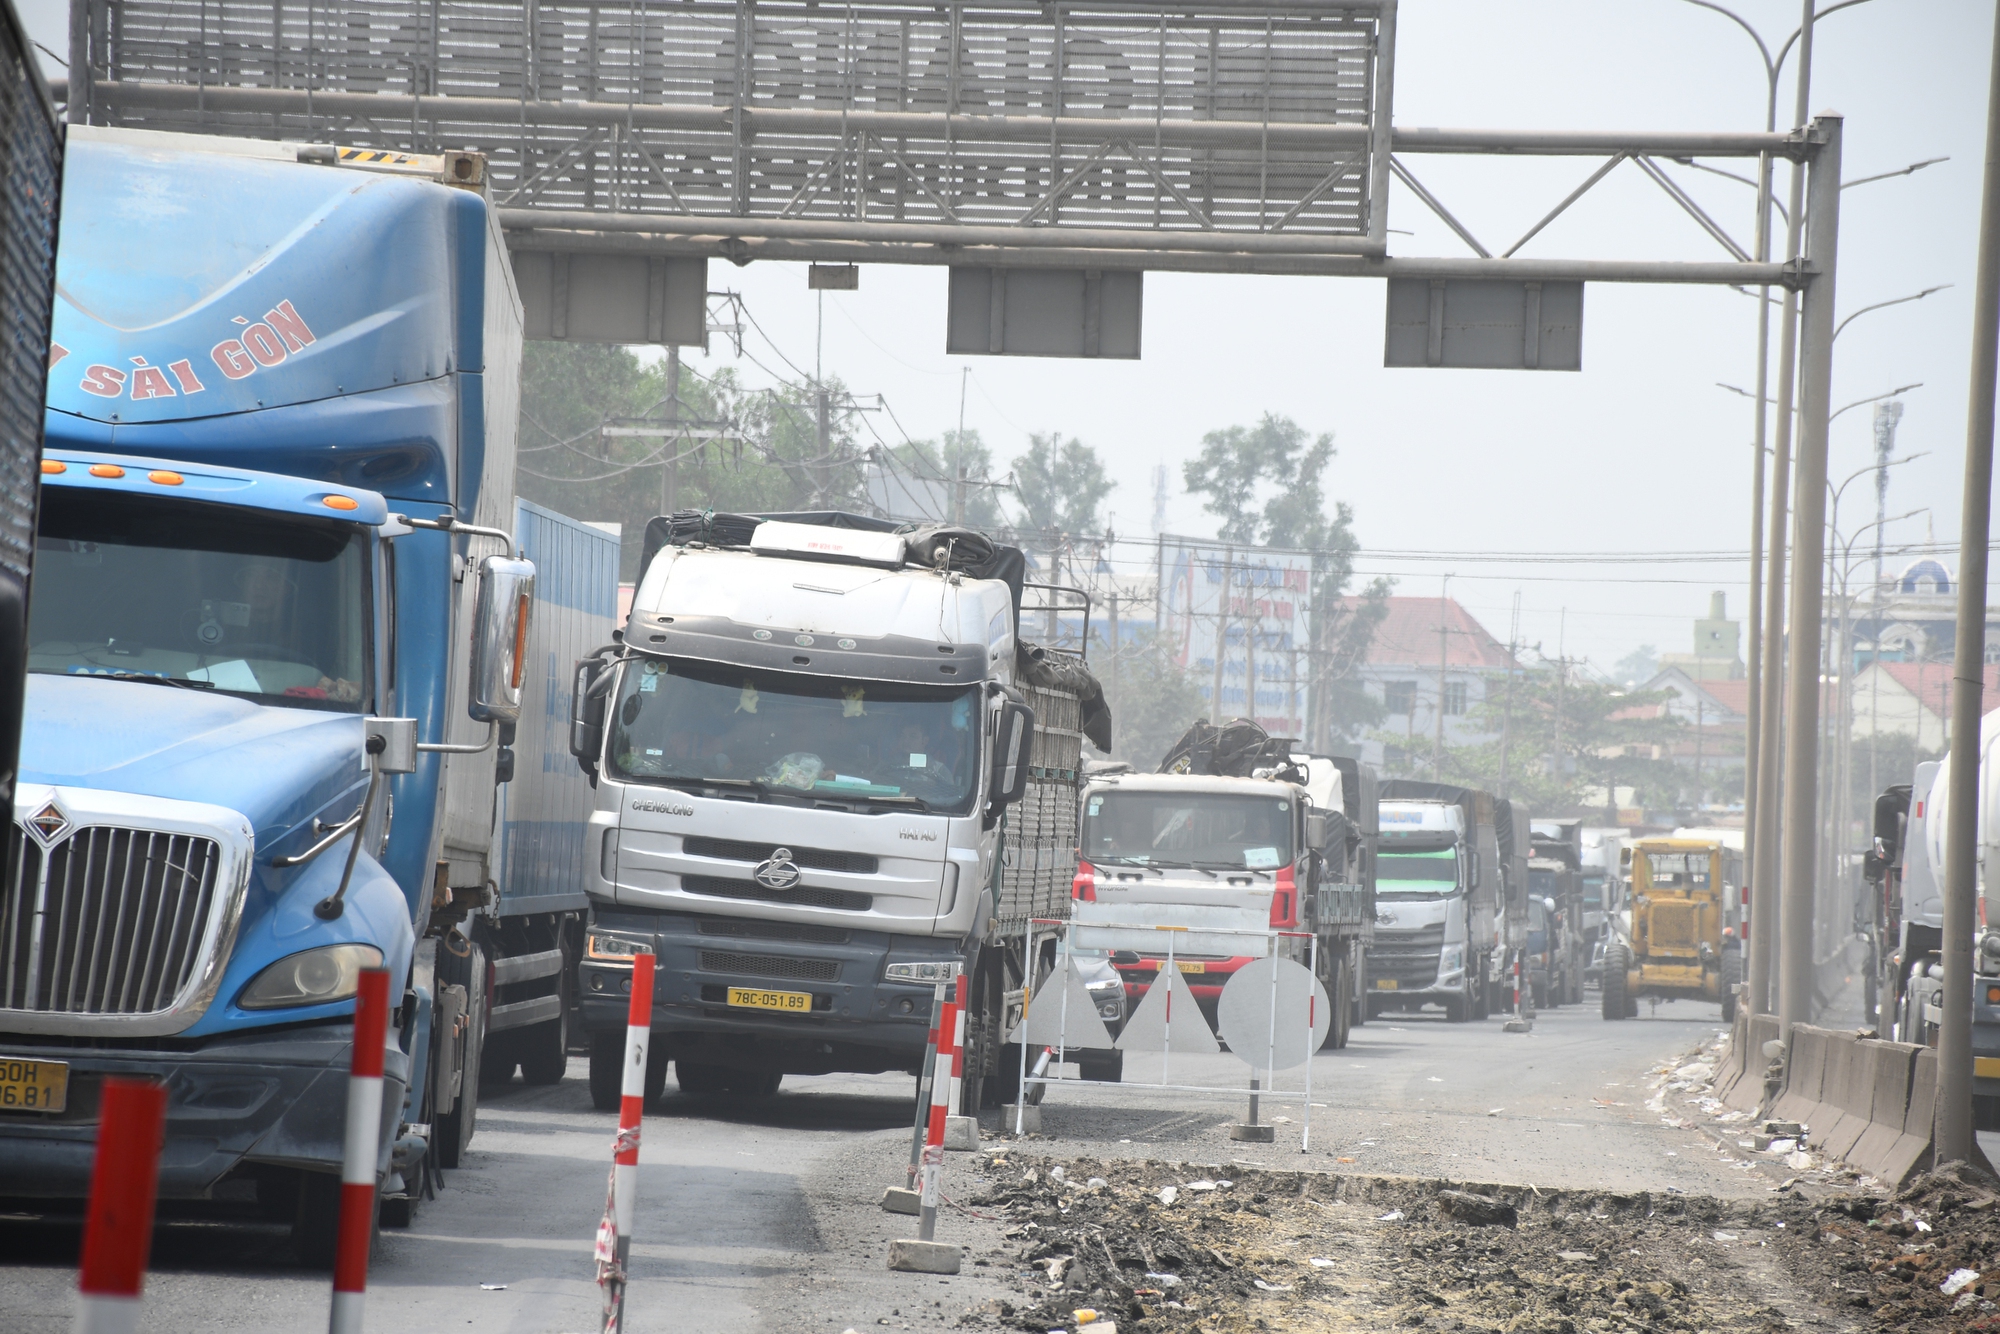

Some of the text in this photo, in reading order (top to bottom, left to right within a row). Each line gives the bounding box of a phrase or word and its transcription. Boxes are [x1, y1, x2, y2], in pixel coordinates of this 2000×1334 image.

[79, 355, 205, 400] SÀI
[210, 298, 317, 380] GÒN
[632, 799, 694, 817] CHENGLONG
[735, 992, 804, 1009] 78C-051.89
[0, 1085, 51, 1107] 6.81
